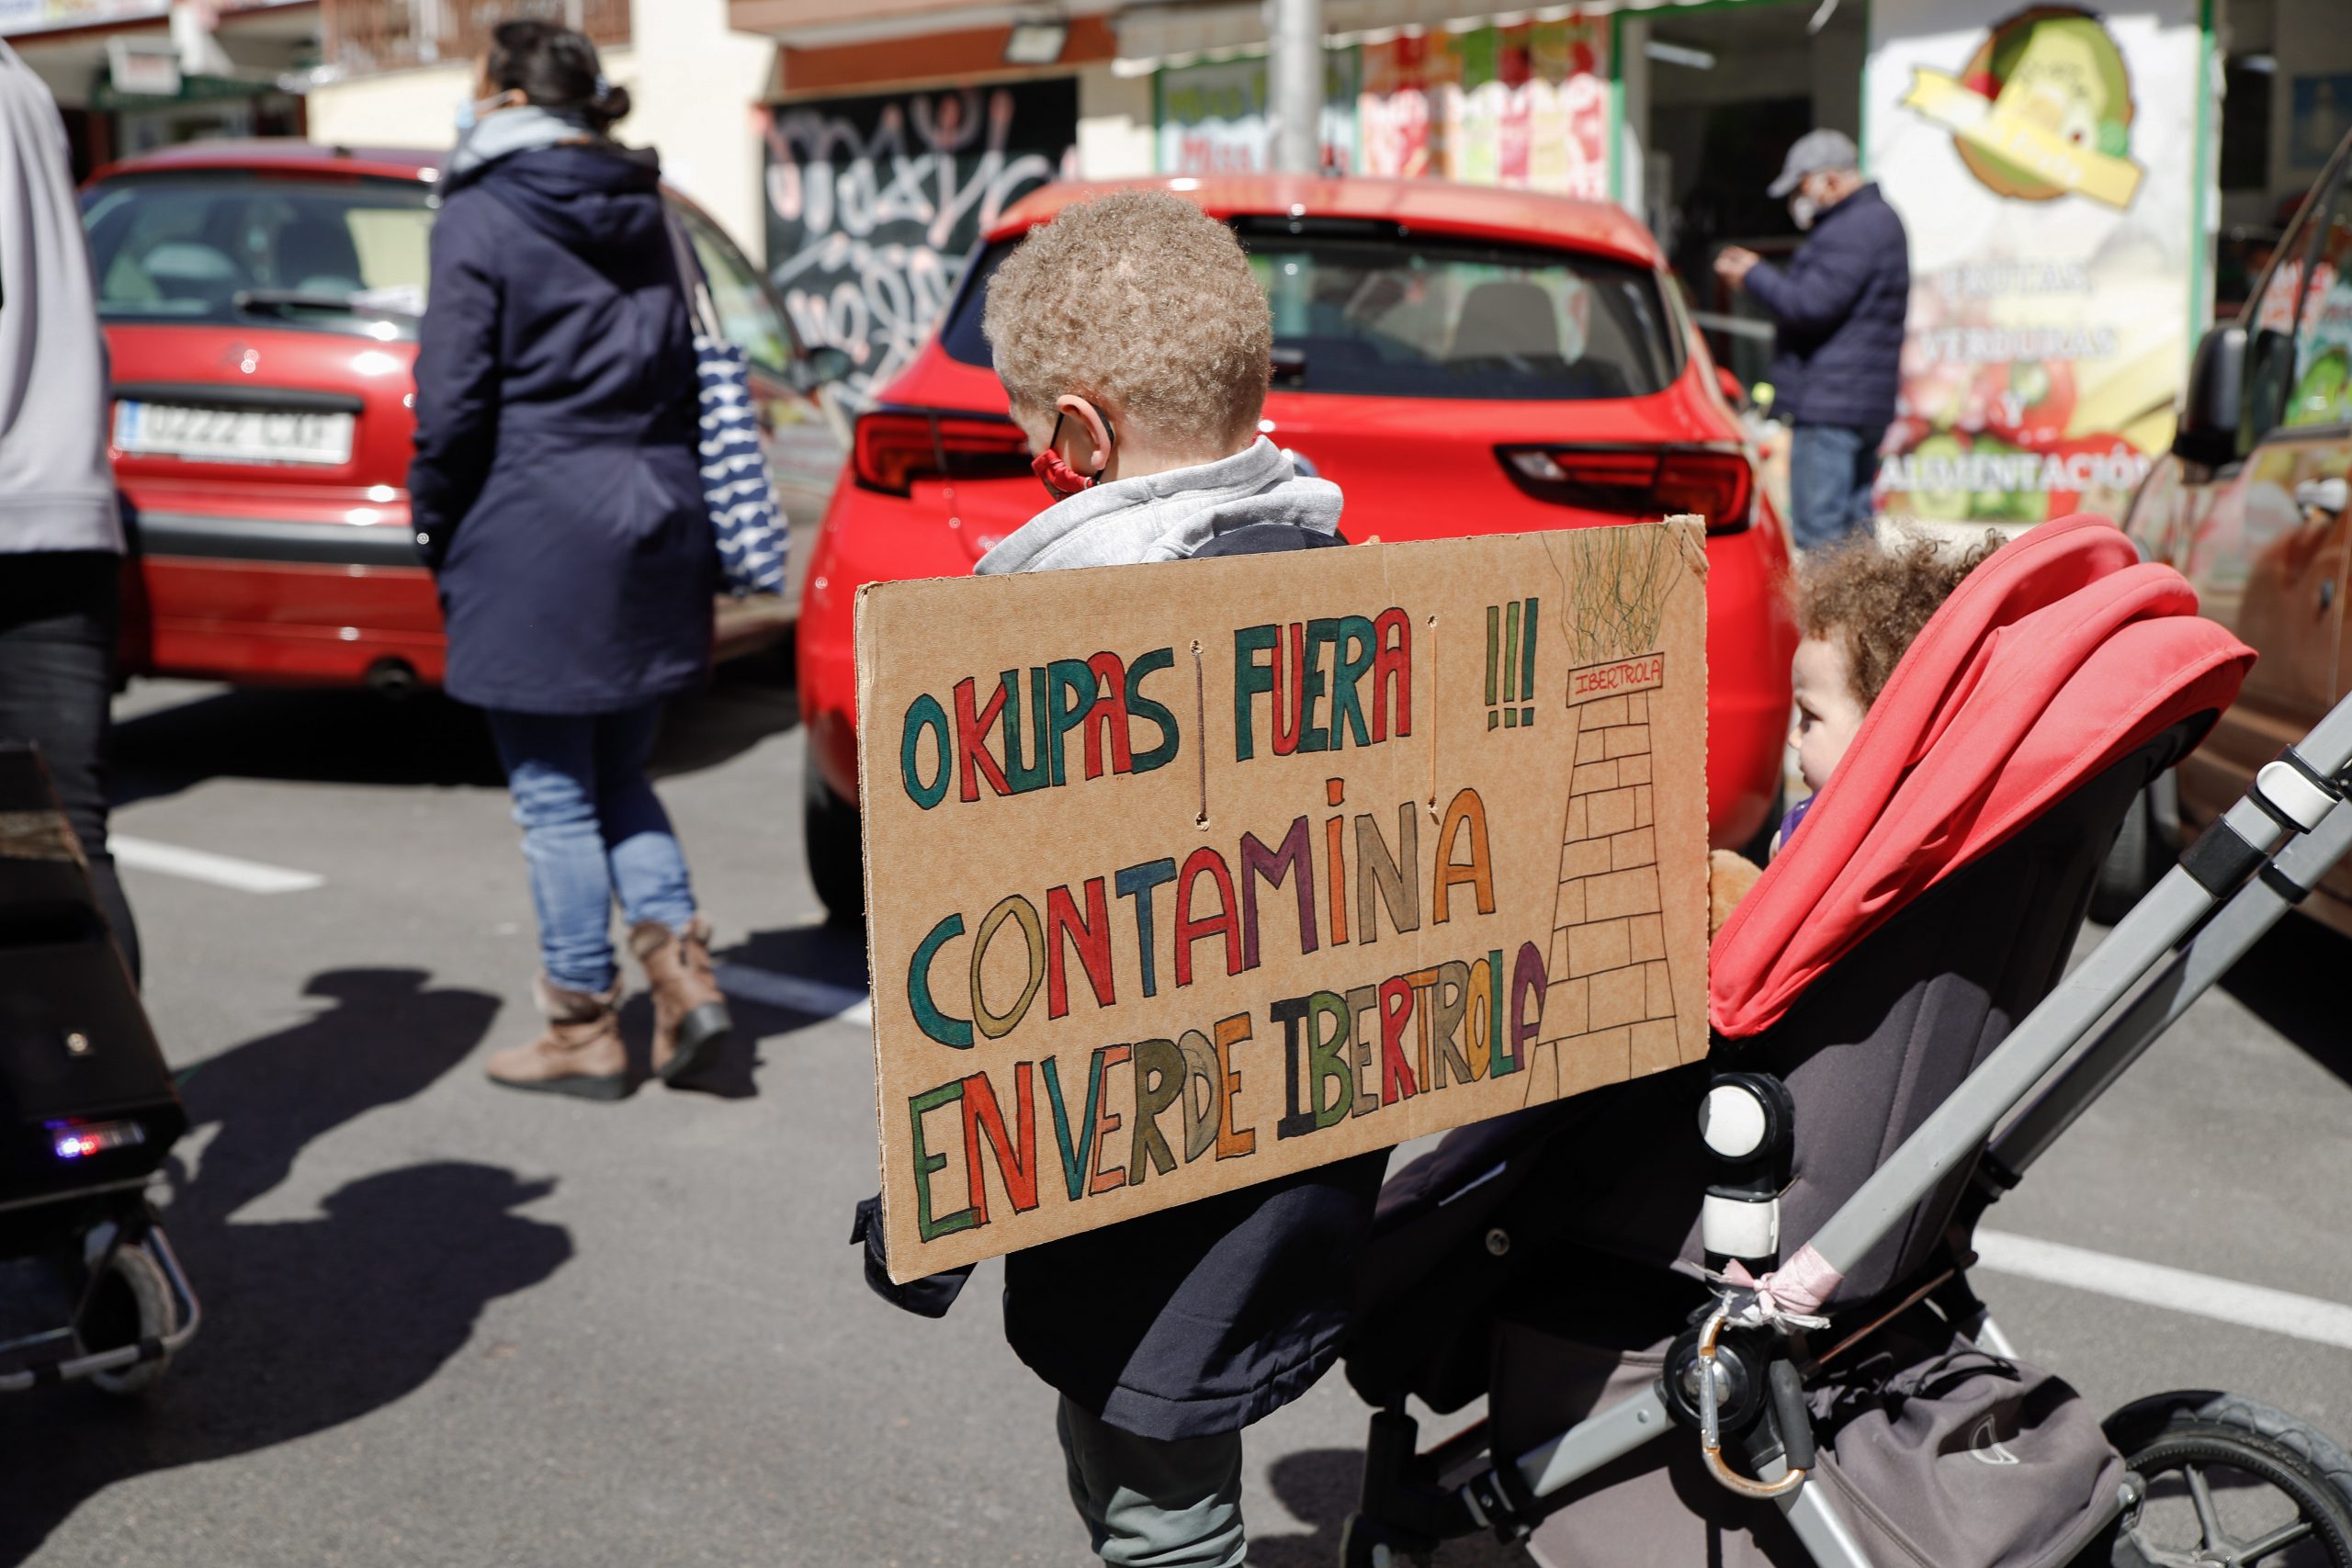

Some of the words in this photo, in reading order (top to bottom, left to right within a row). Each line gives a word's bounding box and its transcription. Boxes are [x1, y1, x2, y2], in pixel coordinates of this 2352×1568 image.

[1942, 263, 2094, 297] FRUTAS
[1919, 325, 2119, 363] VERDURAS
[900, 647, 1180, 810] OKUPAS
[1234, 606, 1412, 762] FUERA
[1575, 660, 1662, 694] IBERTROLA
[907, 777, 1496, 1050] CONTAMINA
[1271, 941, 1548, 1141] IBERTROLA
